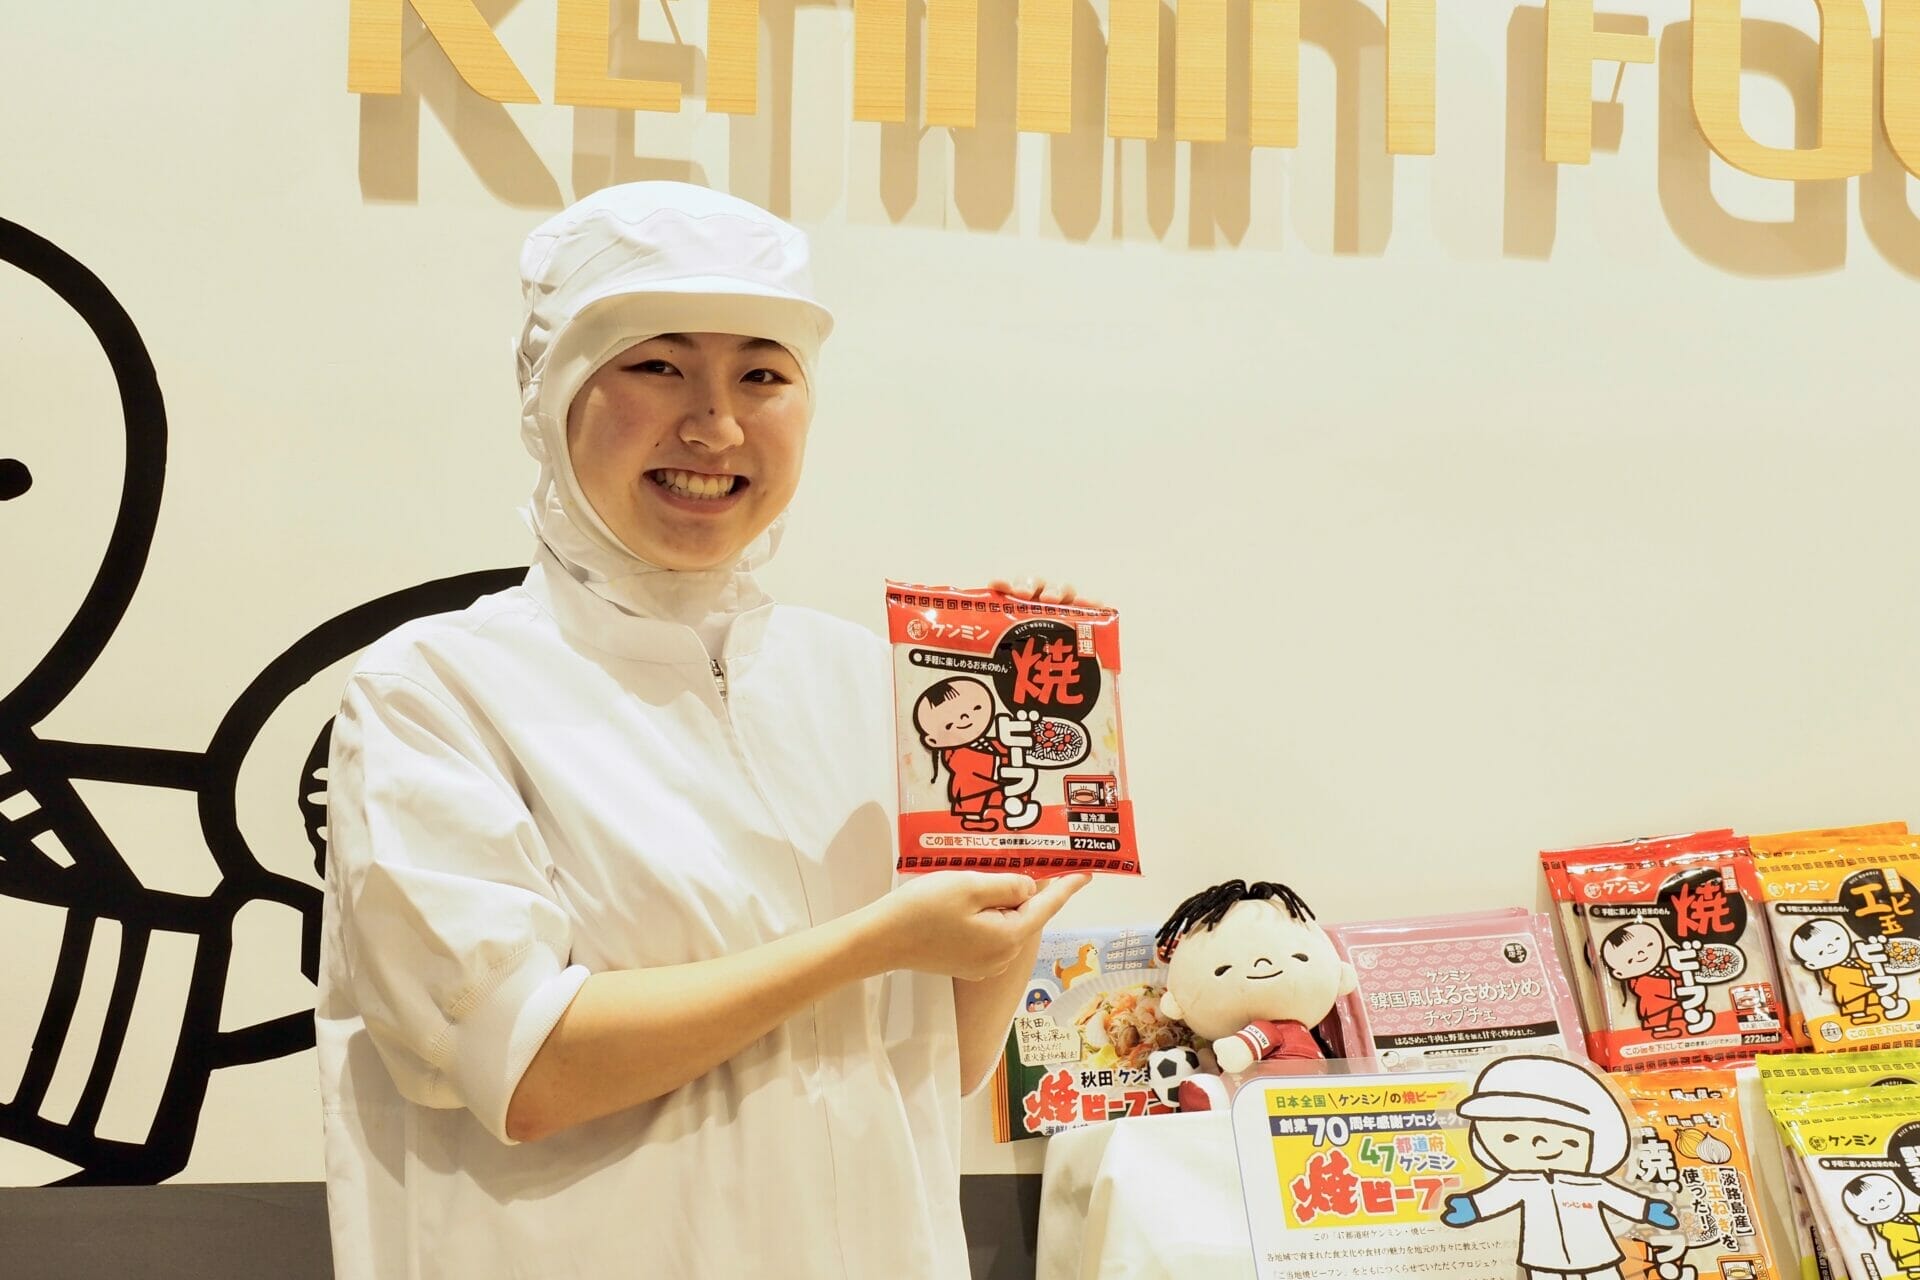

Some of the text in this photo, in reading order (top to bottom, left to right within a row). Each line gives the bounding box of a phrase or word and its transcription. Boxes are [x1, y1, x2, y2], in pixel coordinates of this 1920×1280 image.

[931, 622, 990, 641] ケンミン
[1077, 623, 1095, 655] 調理
[1011, 636, 1084, 705] 焼
[997, 709, 1040, 829] ビーフン
[1096, 823, 1117, 834] 180g
[1073, 837, 1117, 850] 272kcal
[1784, 879, 1830, 894] ケンミン
[1670, 881, 1735, 938] 焼
[1425, 968, 1472, 984] ケンミン
[1854, 934, 1910, 1020] ビーフン
[1368, 977, 1542, 1010] 韓国風はるさめ炒め
[1668, 939, 1714, 1033] ビーフン
[1422, 1005, 1498, 1027] チャプチェ
[1744, 1030, 1779, 1045] 272kcal
[1081, 1070, 1113, 1089] 秋田
[1275, 1094, 1327, 1109] 日本全国
[1338, 1092, 1381, 1108] ケンミン
[1395, 1134, 1445, 1154] 都道府
[1828, 1133, 1878, 1147] ケンミン
[1399, 1154, 1457, 1172] ケンミン
